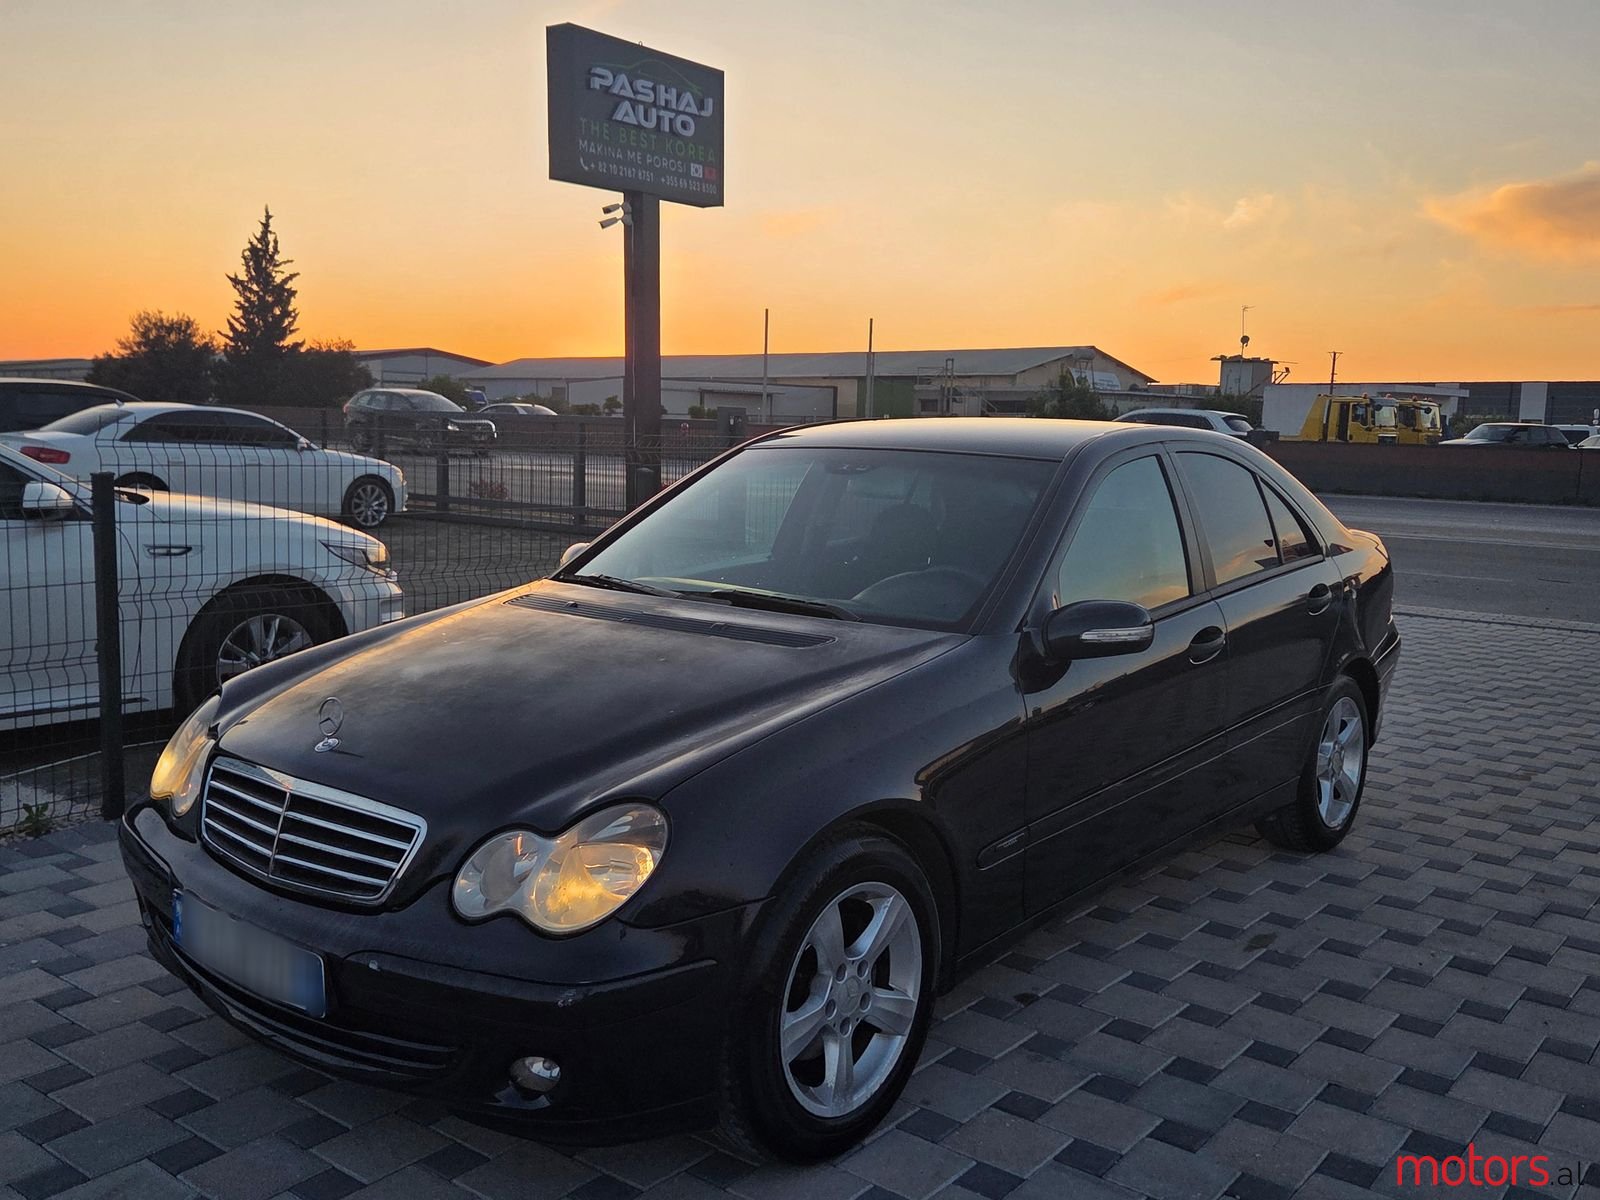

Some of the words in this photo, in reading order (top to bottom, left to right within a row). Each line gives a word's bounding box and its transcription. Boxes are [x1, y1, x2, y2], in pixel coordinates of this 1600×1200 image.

[590, 67, 713, 117] PASHAJ
[612, 101, 695, 137] AUTO
[579, 139, 623, 160] MAKINA
[628, 150, 642, 164] ME
[646, 154, 686, 173] POROSI
[580, 118, 609, 139] THE
[620, 128, 657, 151] BEST
[666, 138, 716, 162] KOREA
